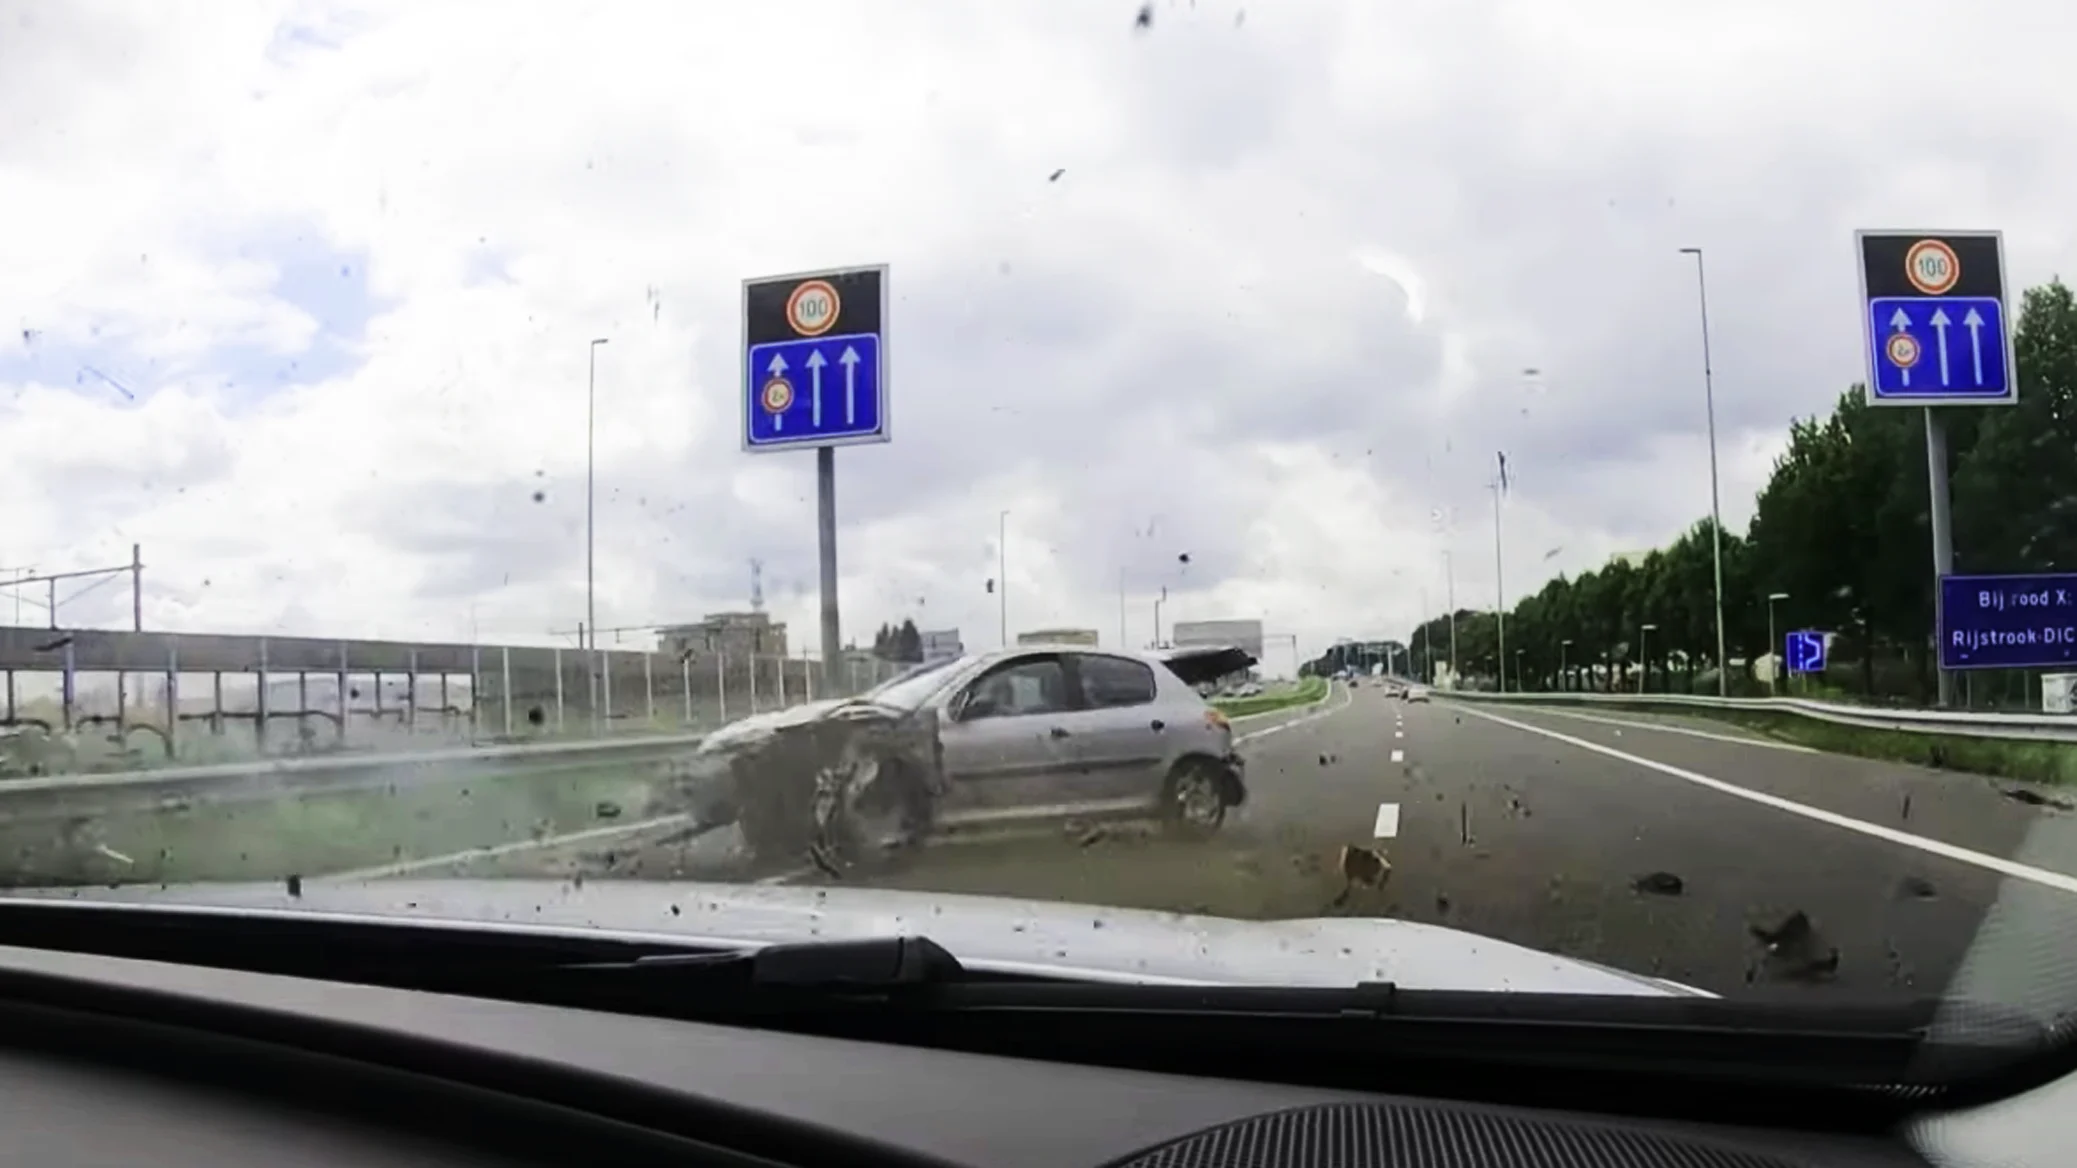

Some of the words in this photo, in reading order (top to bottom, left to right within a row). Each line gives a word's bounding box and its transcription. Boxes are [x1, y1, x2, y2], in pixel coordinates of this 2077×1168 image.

[1918, 257, 1947, 277] 100
[799, 297, 827, 318] 100
[1978, 590, 2004, 611] Bij
[2011, 590, 2049, 606] rood
[1952, 628, 2037, 651] Rijstrook
